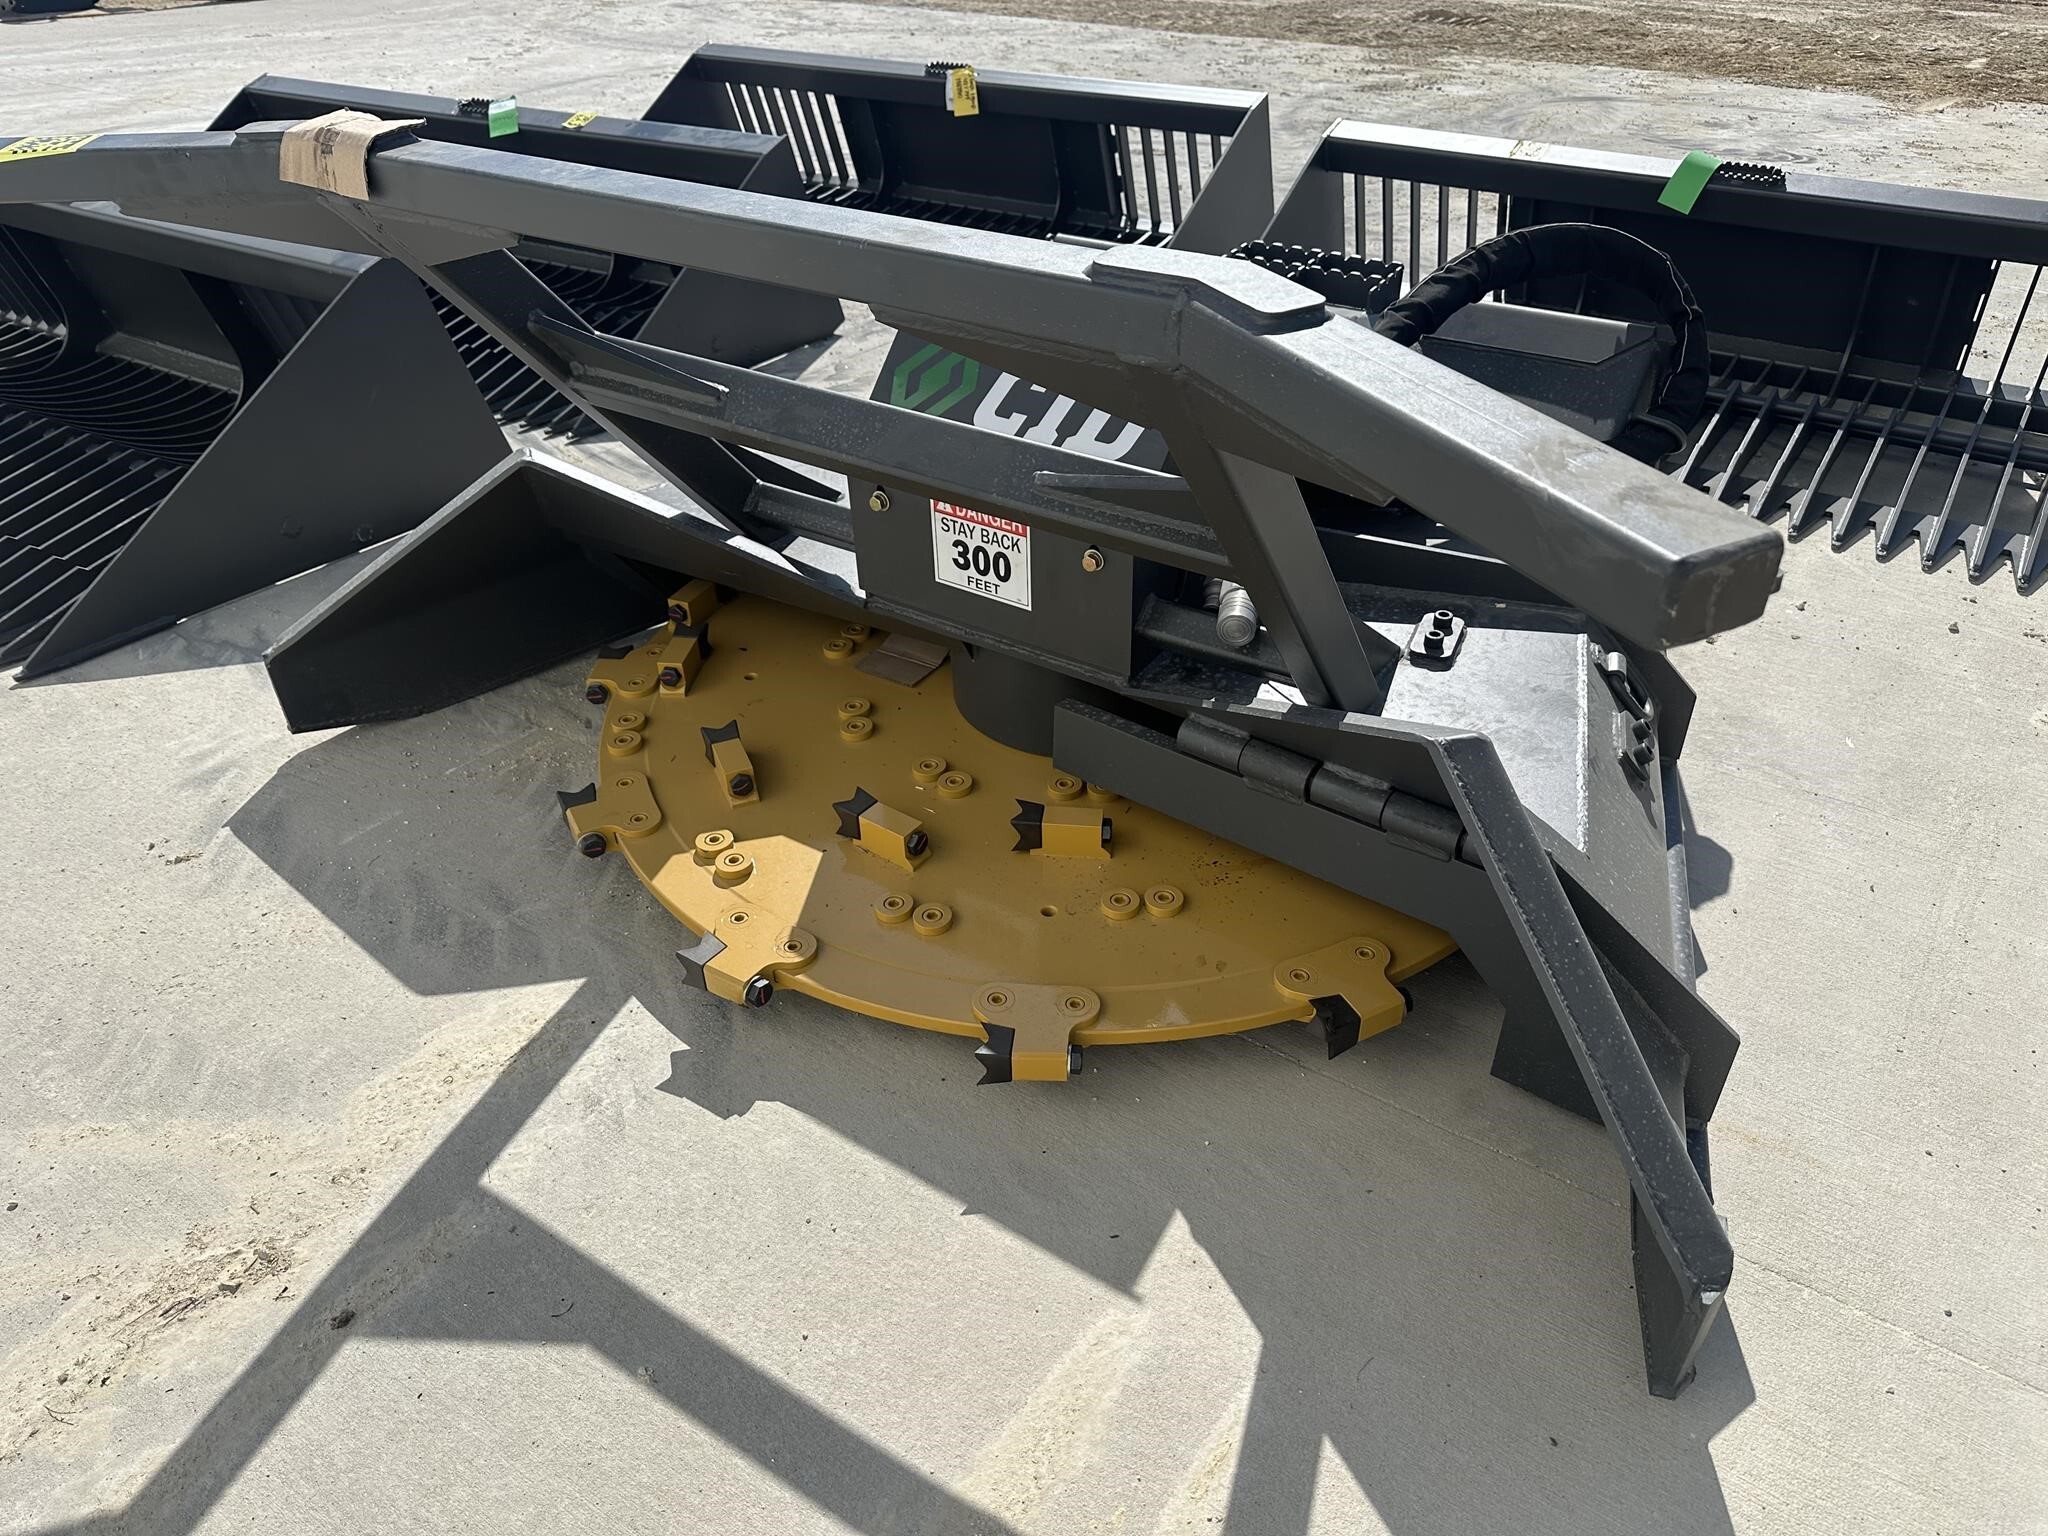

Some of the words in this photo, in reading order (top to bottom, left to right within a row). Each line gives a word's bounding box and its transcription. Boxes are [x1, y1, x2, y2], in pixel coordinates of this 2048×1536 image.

[941, 517, 976, 540] STAY
[981, 528, 1021, 553] BACK
[952, 539, 1012, 583] 300
[967, 576, 1001, 595] FEET
